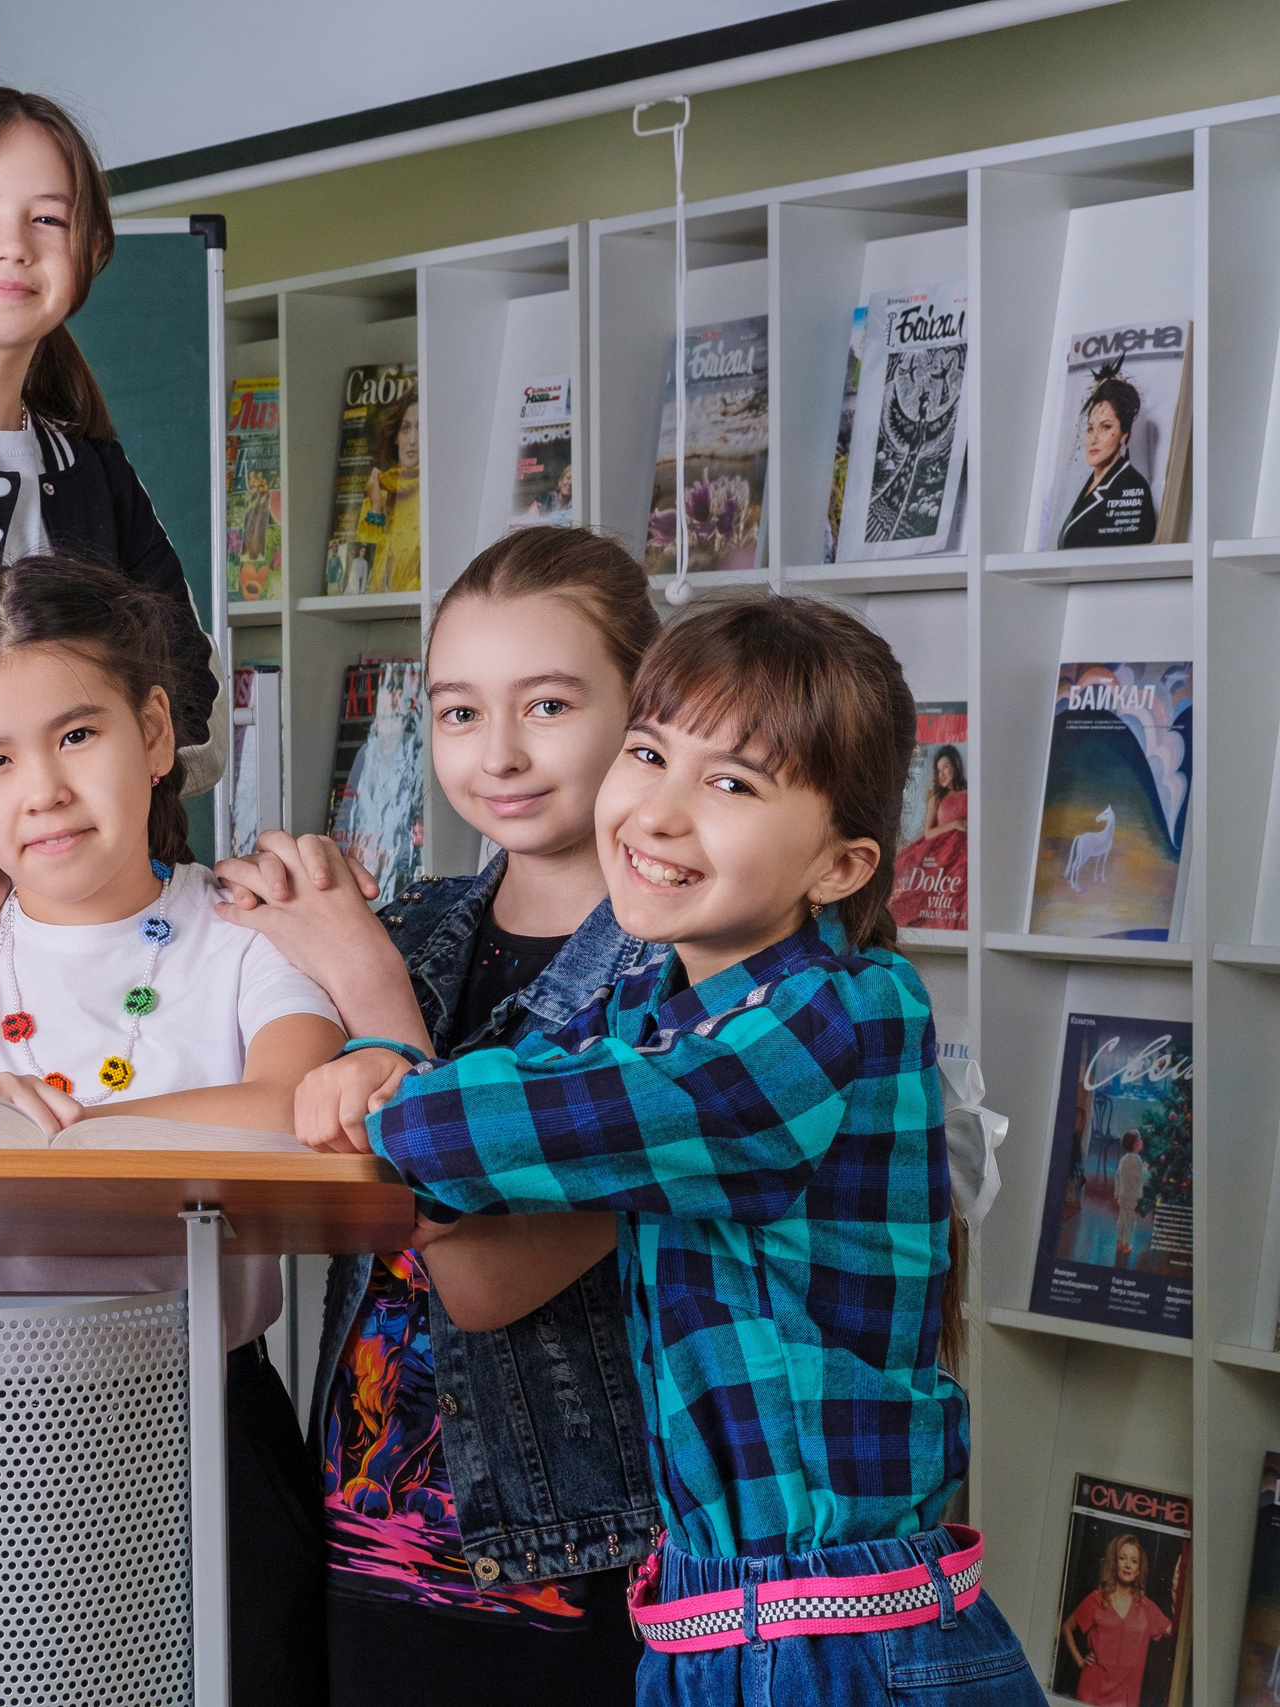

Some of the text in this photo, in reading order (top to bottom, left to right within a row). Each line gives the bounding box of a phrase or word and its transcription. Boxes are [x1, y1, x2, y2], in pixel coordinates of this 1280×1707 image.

[346, 368, 418, 407] Сабр
[229, 391, 280, 430] Лиз
[1068, 678, 1156, 711] БАЙКАЛ
[908, 867, 962, 893] Dolce
[928, 892, 953, 909] vita
